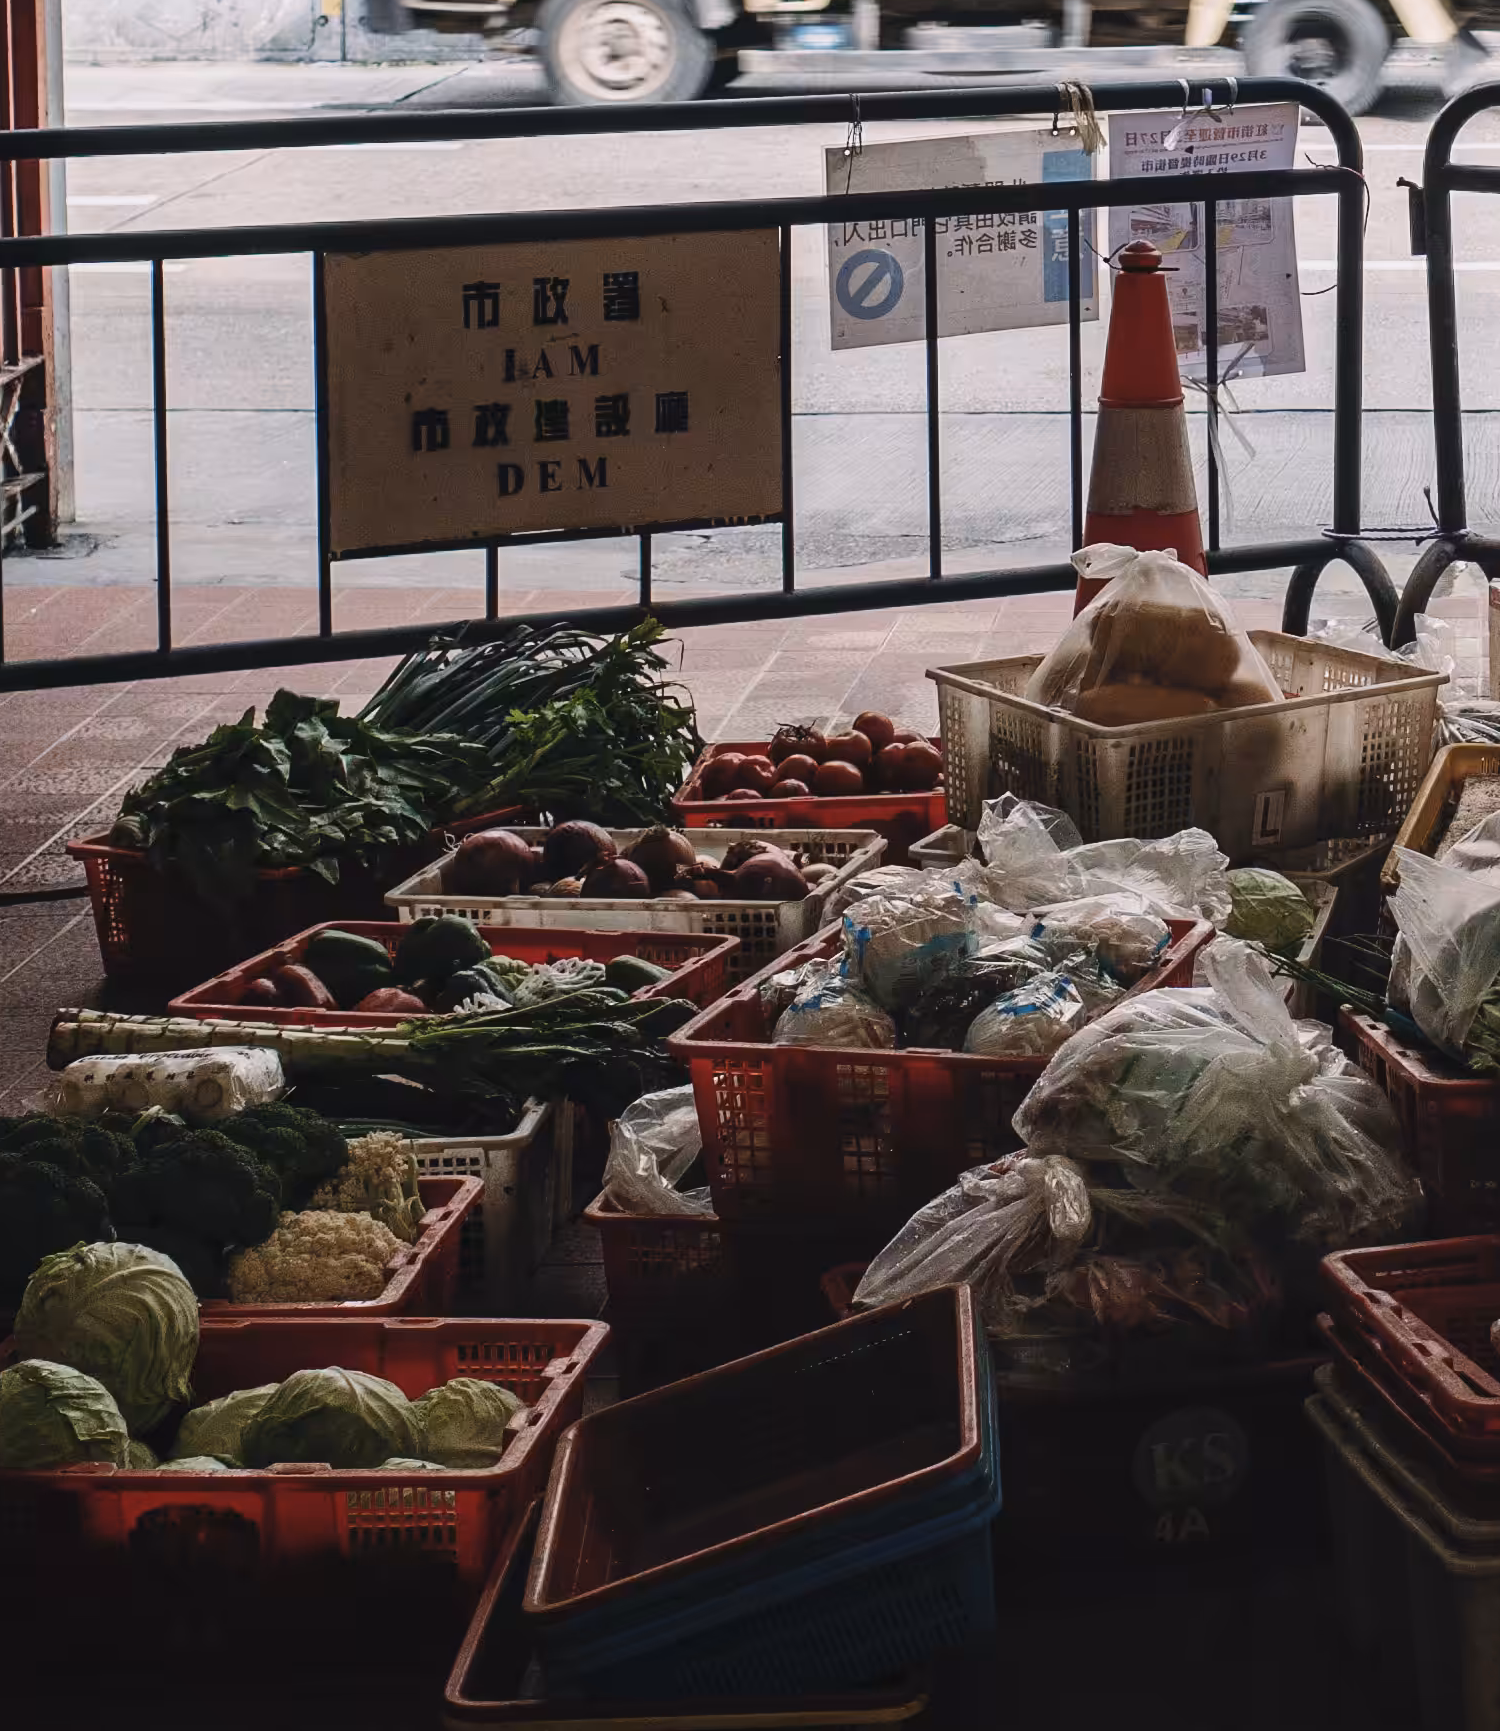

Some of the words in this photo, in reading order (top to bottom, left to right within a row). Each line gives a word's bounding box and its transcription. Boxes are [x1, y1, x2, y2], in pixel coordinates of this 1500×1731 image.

[462, 271, 640, 330] 市政署
[497, 457, 609, 497] DEM
[1260, 796, 1279, 839] L
